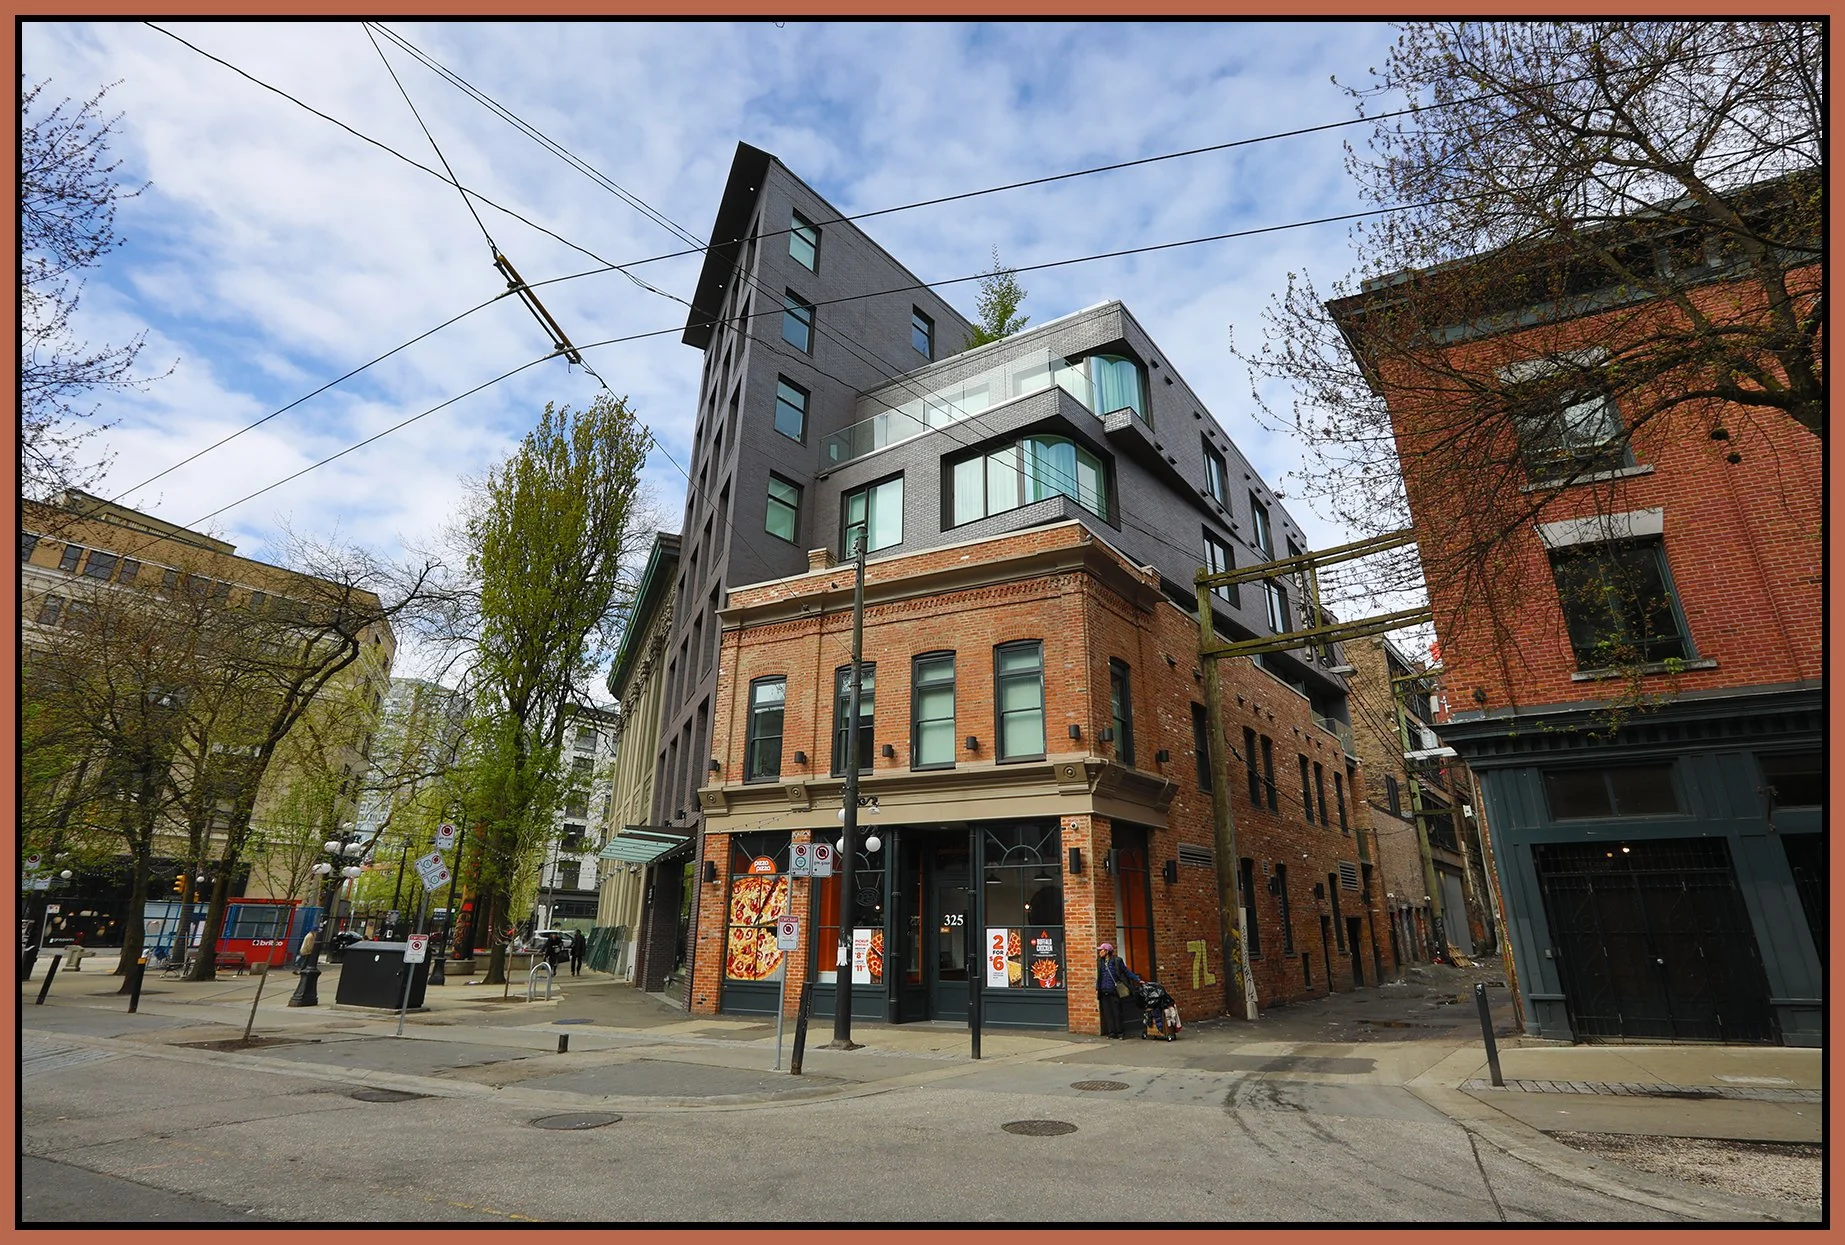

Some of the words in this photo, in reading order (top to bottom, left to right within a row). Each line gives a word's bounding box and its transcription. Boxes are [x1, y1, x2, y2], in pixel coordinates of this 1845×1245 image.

[944, 914, 964, 926] 325
[992, 934, 1004, 950] 2
[989, 956, 1004, 971] $6
